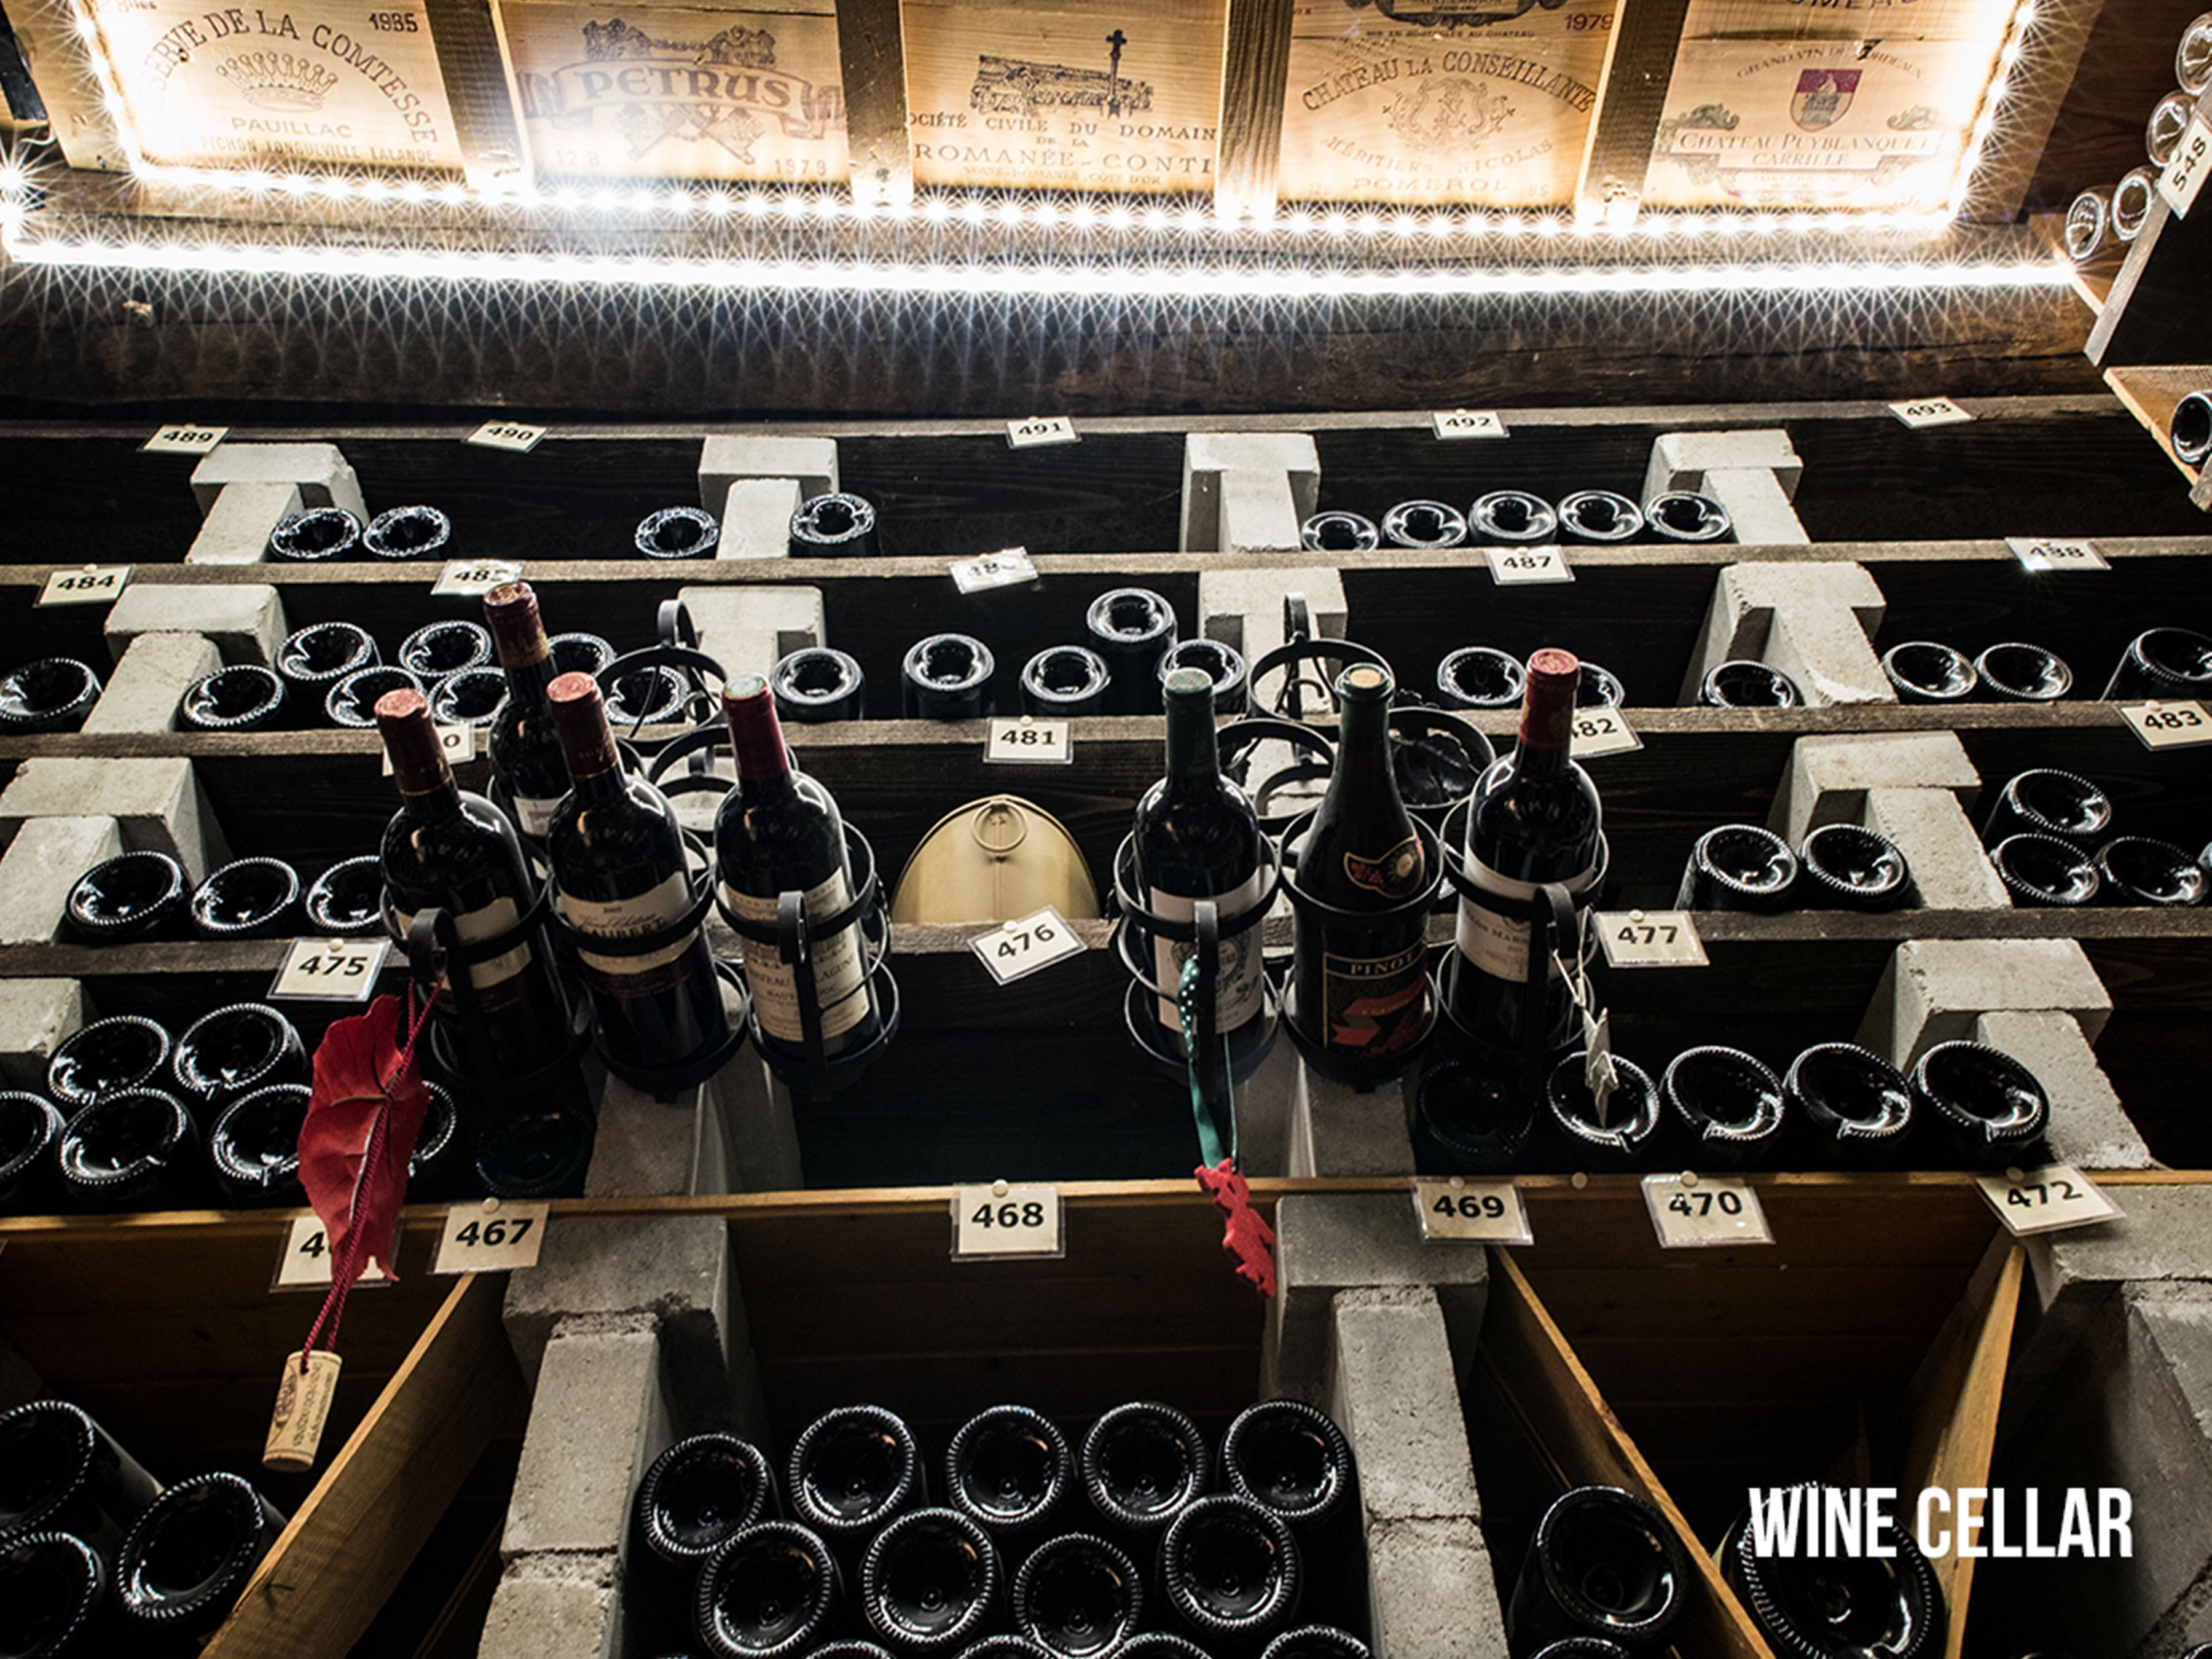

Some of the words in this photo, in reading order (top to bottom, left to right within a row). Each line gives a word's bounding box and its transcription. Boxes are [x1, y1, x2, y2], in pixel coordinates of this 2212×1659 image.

[1564, 14, 1614, 31] 1979
[203, 9, 250, 39] DE
[256, 9, 300, 41] LA
[311, 23, 438, 144] COMTESSE
[1301, 58, 1399, 111] CHATEAU
[1406, 57, 1433, 77] LA
[1442, 50, 1597, 113] CONSEILLANTE
[573, 66, 793, 108] PETRUS
[232, 117, 353, 139] PAUILLAC
[985, 117, 1048, 131] CIVILE
[1070, 122, 1099, 135] DU
[201, 136, 257, 154] PICHON
[1072, 139, 1090, 148] LA
[1457, 140, 1555, 174] NICOLAS
[1352, 176, 1509, 192] POMEROL
[1907, 402, 1952, 417] 493
[1019, 422, 1064, 436] 491
[1445, 417, 1491, 428] 492
[162, 429, 214, 444] 489
[486, 425, 535, 441] 490
[1503, 556, 1551, 569] 487
[57, 575, 116, 590] 484
[2144, 710, 2203, 729] 483
[1000, 729, 1057, 746] 481
[997, 924, 1056, 960] 476
[1618, 925, 1679, 945] 477
[299, 955, 367, 977] 475
[1351, 954, 1415, 976] PINOT
[2007, 1180, 2083, 1207] 472
[1432, 1196, 1505, 1218] 469
[1668, 1191, 1743, 1217] 470
[971, 1202, 1045, 1228] 468
[455, 1219, 535, 1247] 467
